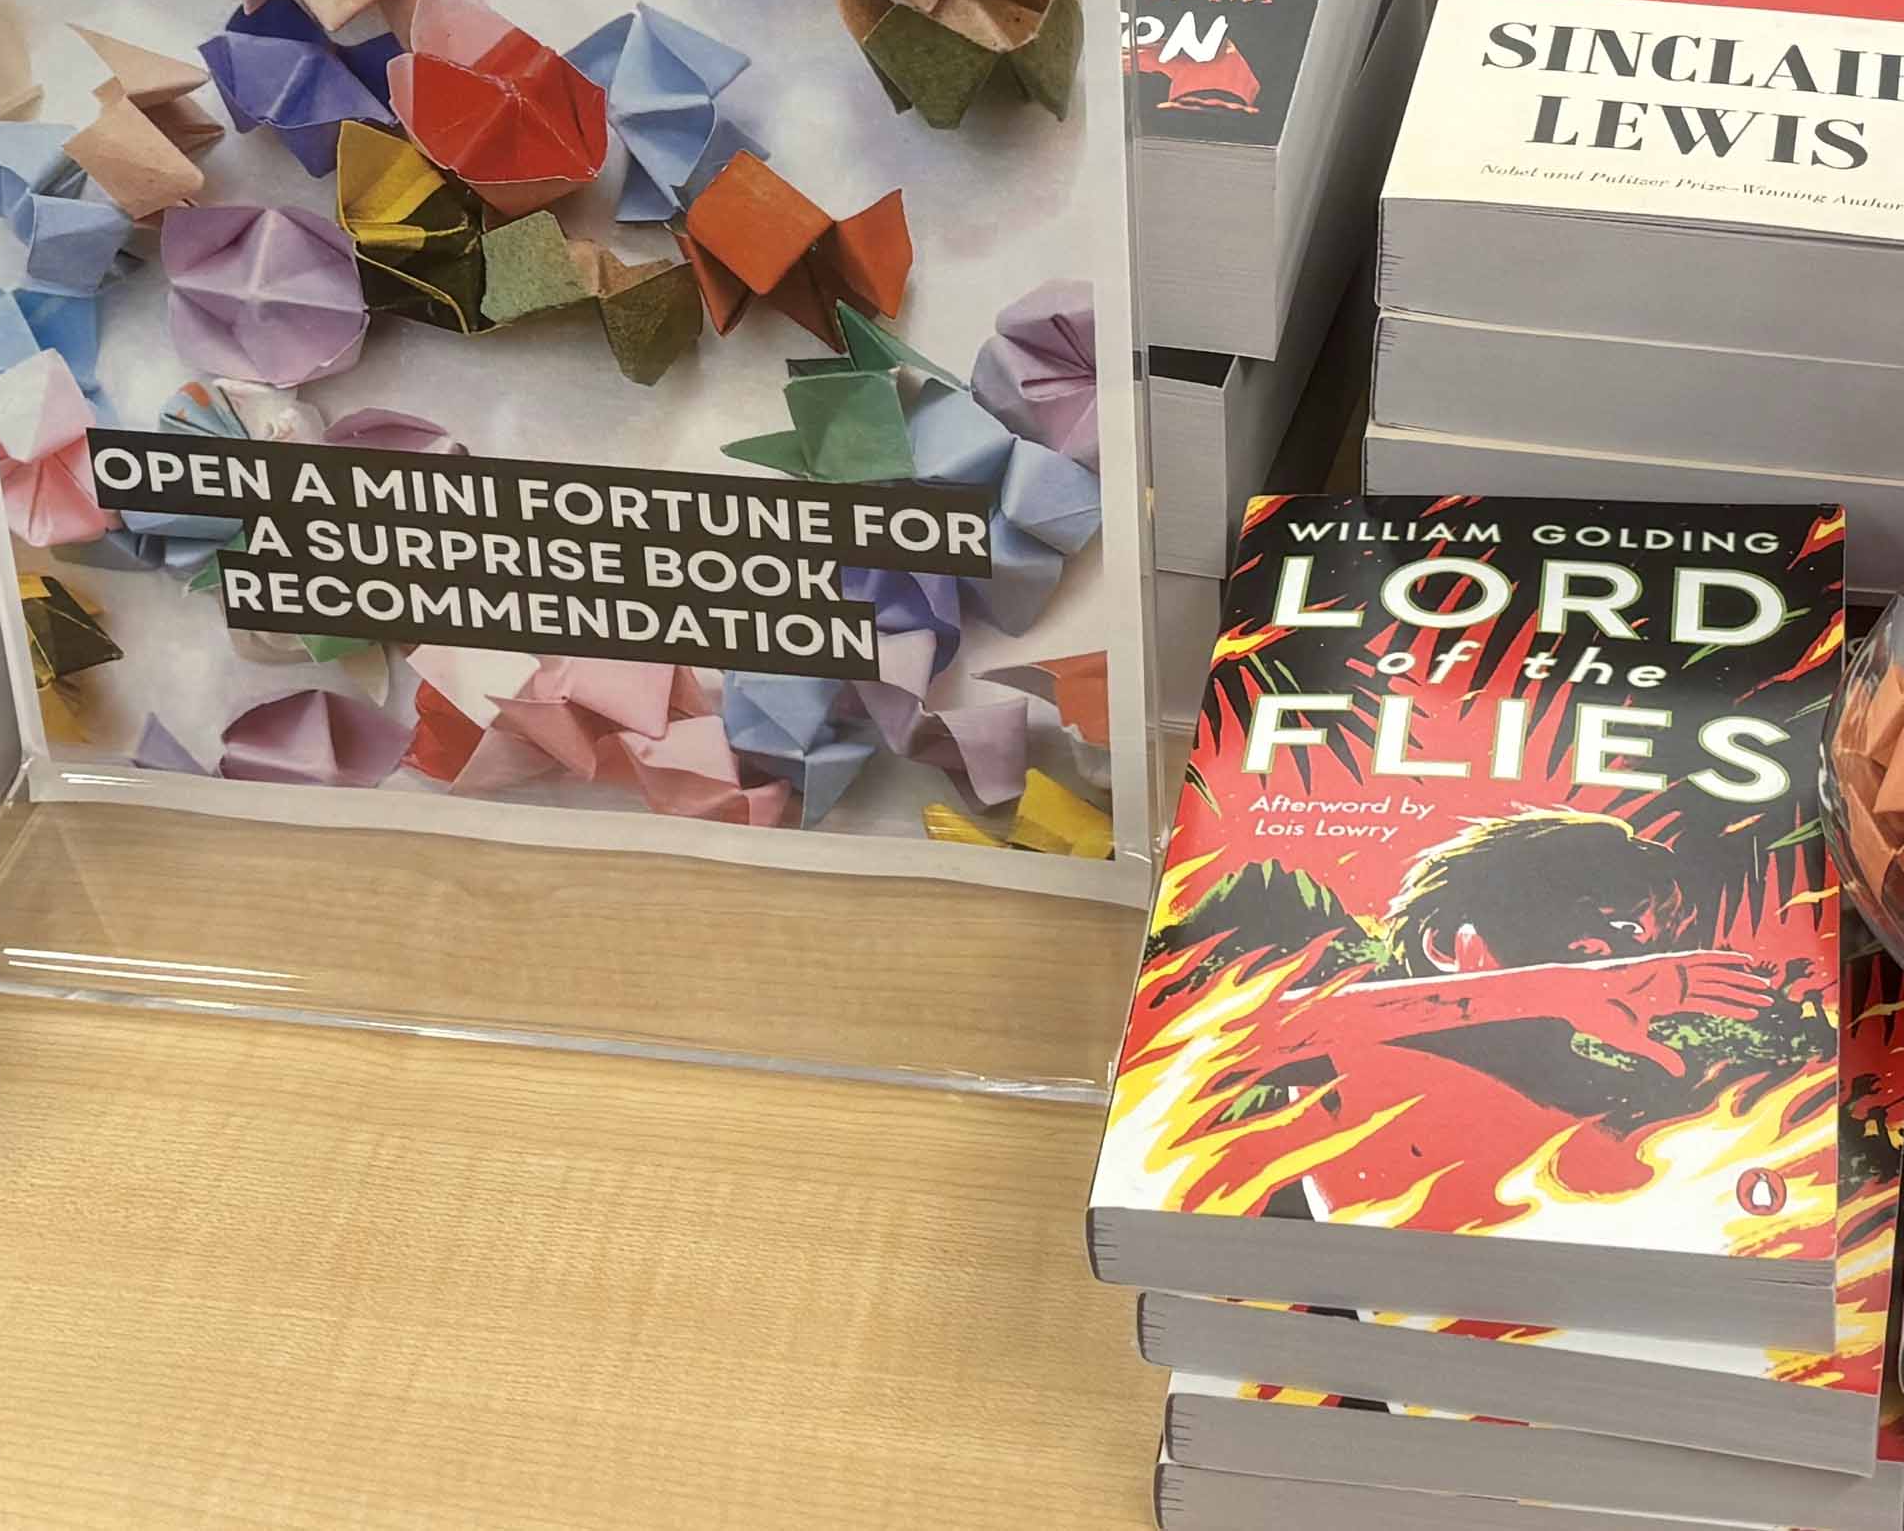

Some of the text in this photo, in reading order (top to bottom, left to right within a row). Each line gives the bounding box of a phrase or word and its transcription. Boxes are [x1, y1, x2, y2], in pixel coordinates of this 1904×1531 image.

[1525, 94, 1869, 172] LEWIS
[1480, 164, 1904, 212] Nobel and Pulitzer Author
[94, 447, 989, 559] OPEN A MINI FORTUNE FOR
[1286, 522, 1781, 555] WILLIAM GOLDING
[246, 516, 844, 602] A SURPRISE BOOK
[224, 568, 876, 662] RECOMMENDATION
[1271, 554, 1788, 648] LORD
[1376, 640, 1669, 689] of the
[1241, 693, 1792, 804] FLIES
[1249, 795, 1435, 821] Afterword by
[1254, 817, 1399, 845] Lois Lowry
